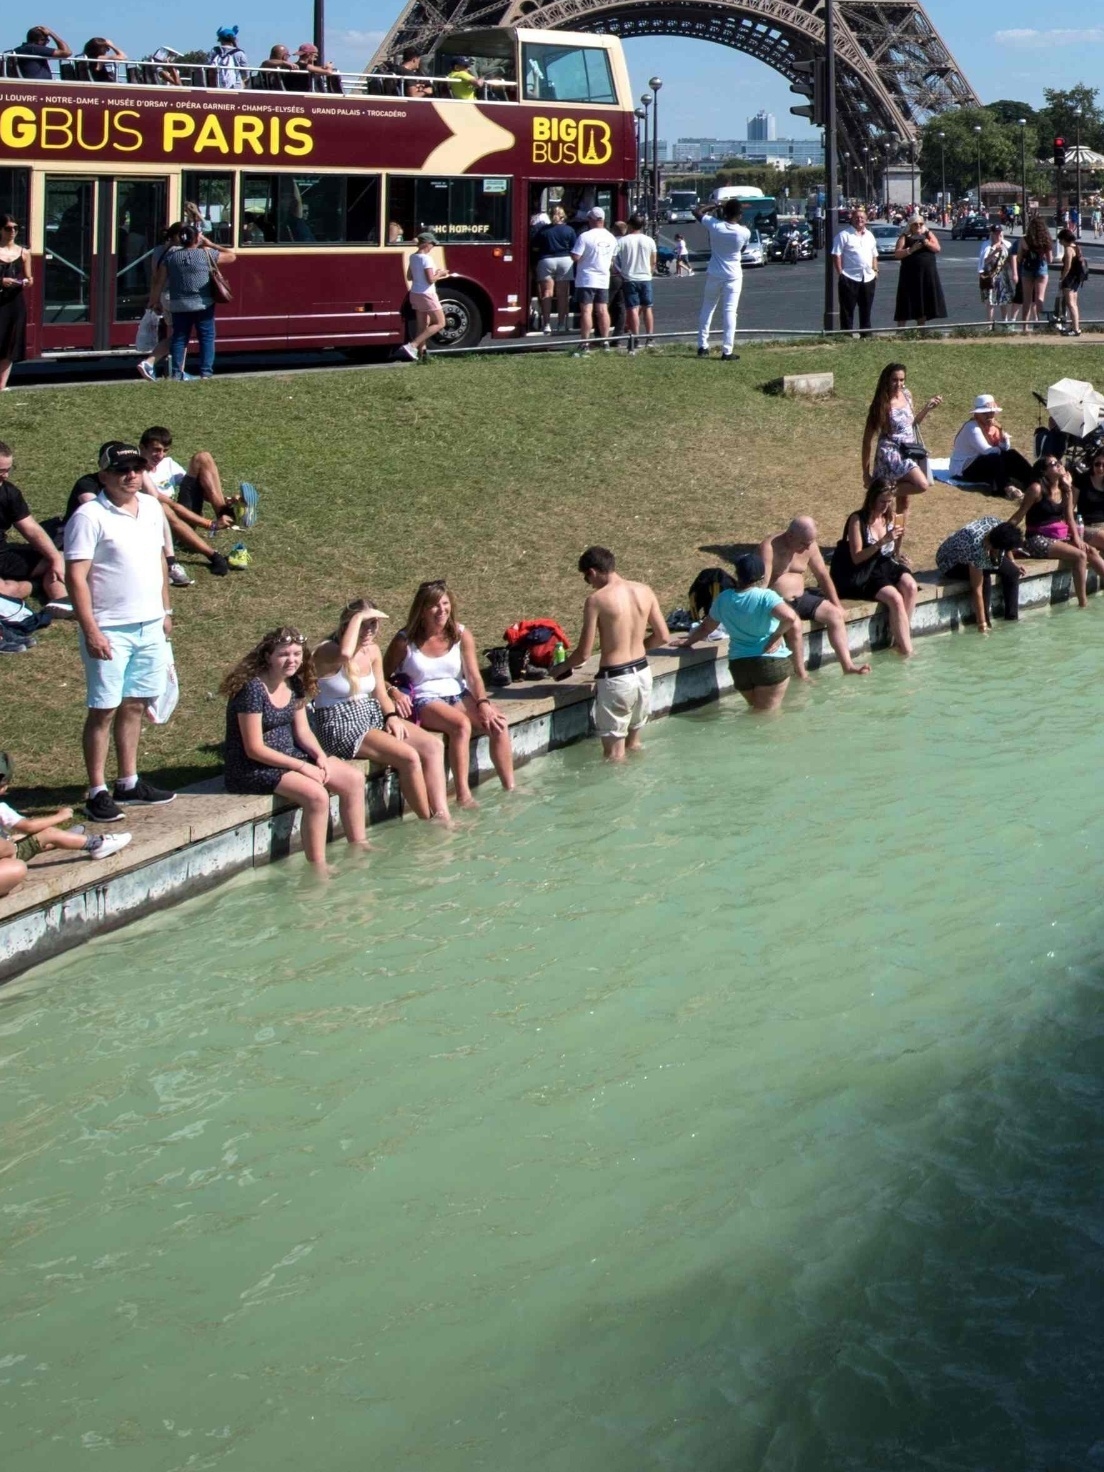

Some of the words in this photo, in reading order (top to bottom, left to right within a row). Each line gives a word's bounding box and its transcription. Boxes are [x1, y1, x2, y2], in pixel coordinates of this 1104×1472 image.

[5, 94, 38, 102] LOUVRE
[45, 96, 99, 105] NOTRE-DAME
[107, 97, 135, 107] MUSÉE
[137, 100, 168, 108] D'ORSAY
[176, 100, 201, 109] OPÉRA
[202, 103, 235, 111] GARNIER
[242, 104, 305, 114] CHAMPS-ELYSÉES
[337, 108, 361, 116] PALAIS
[367, 109, 406, 118] TROCADÉRO
[163, 113, 314, 156] PARIS
[532, 116, 578, 142] BIG
[532, 141, 577, 164] BUS
